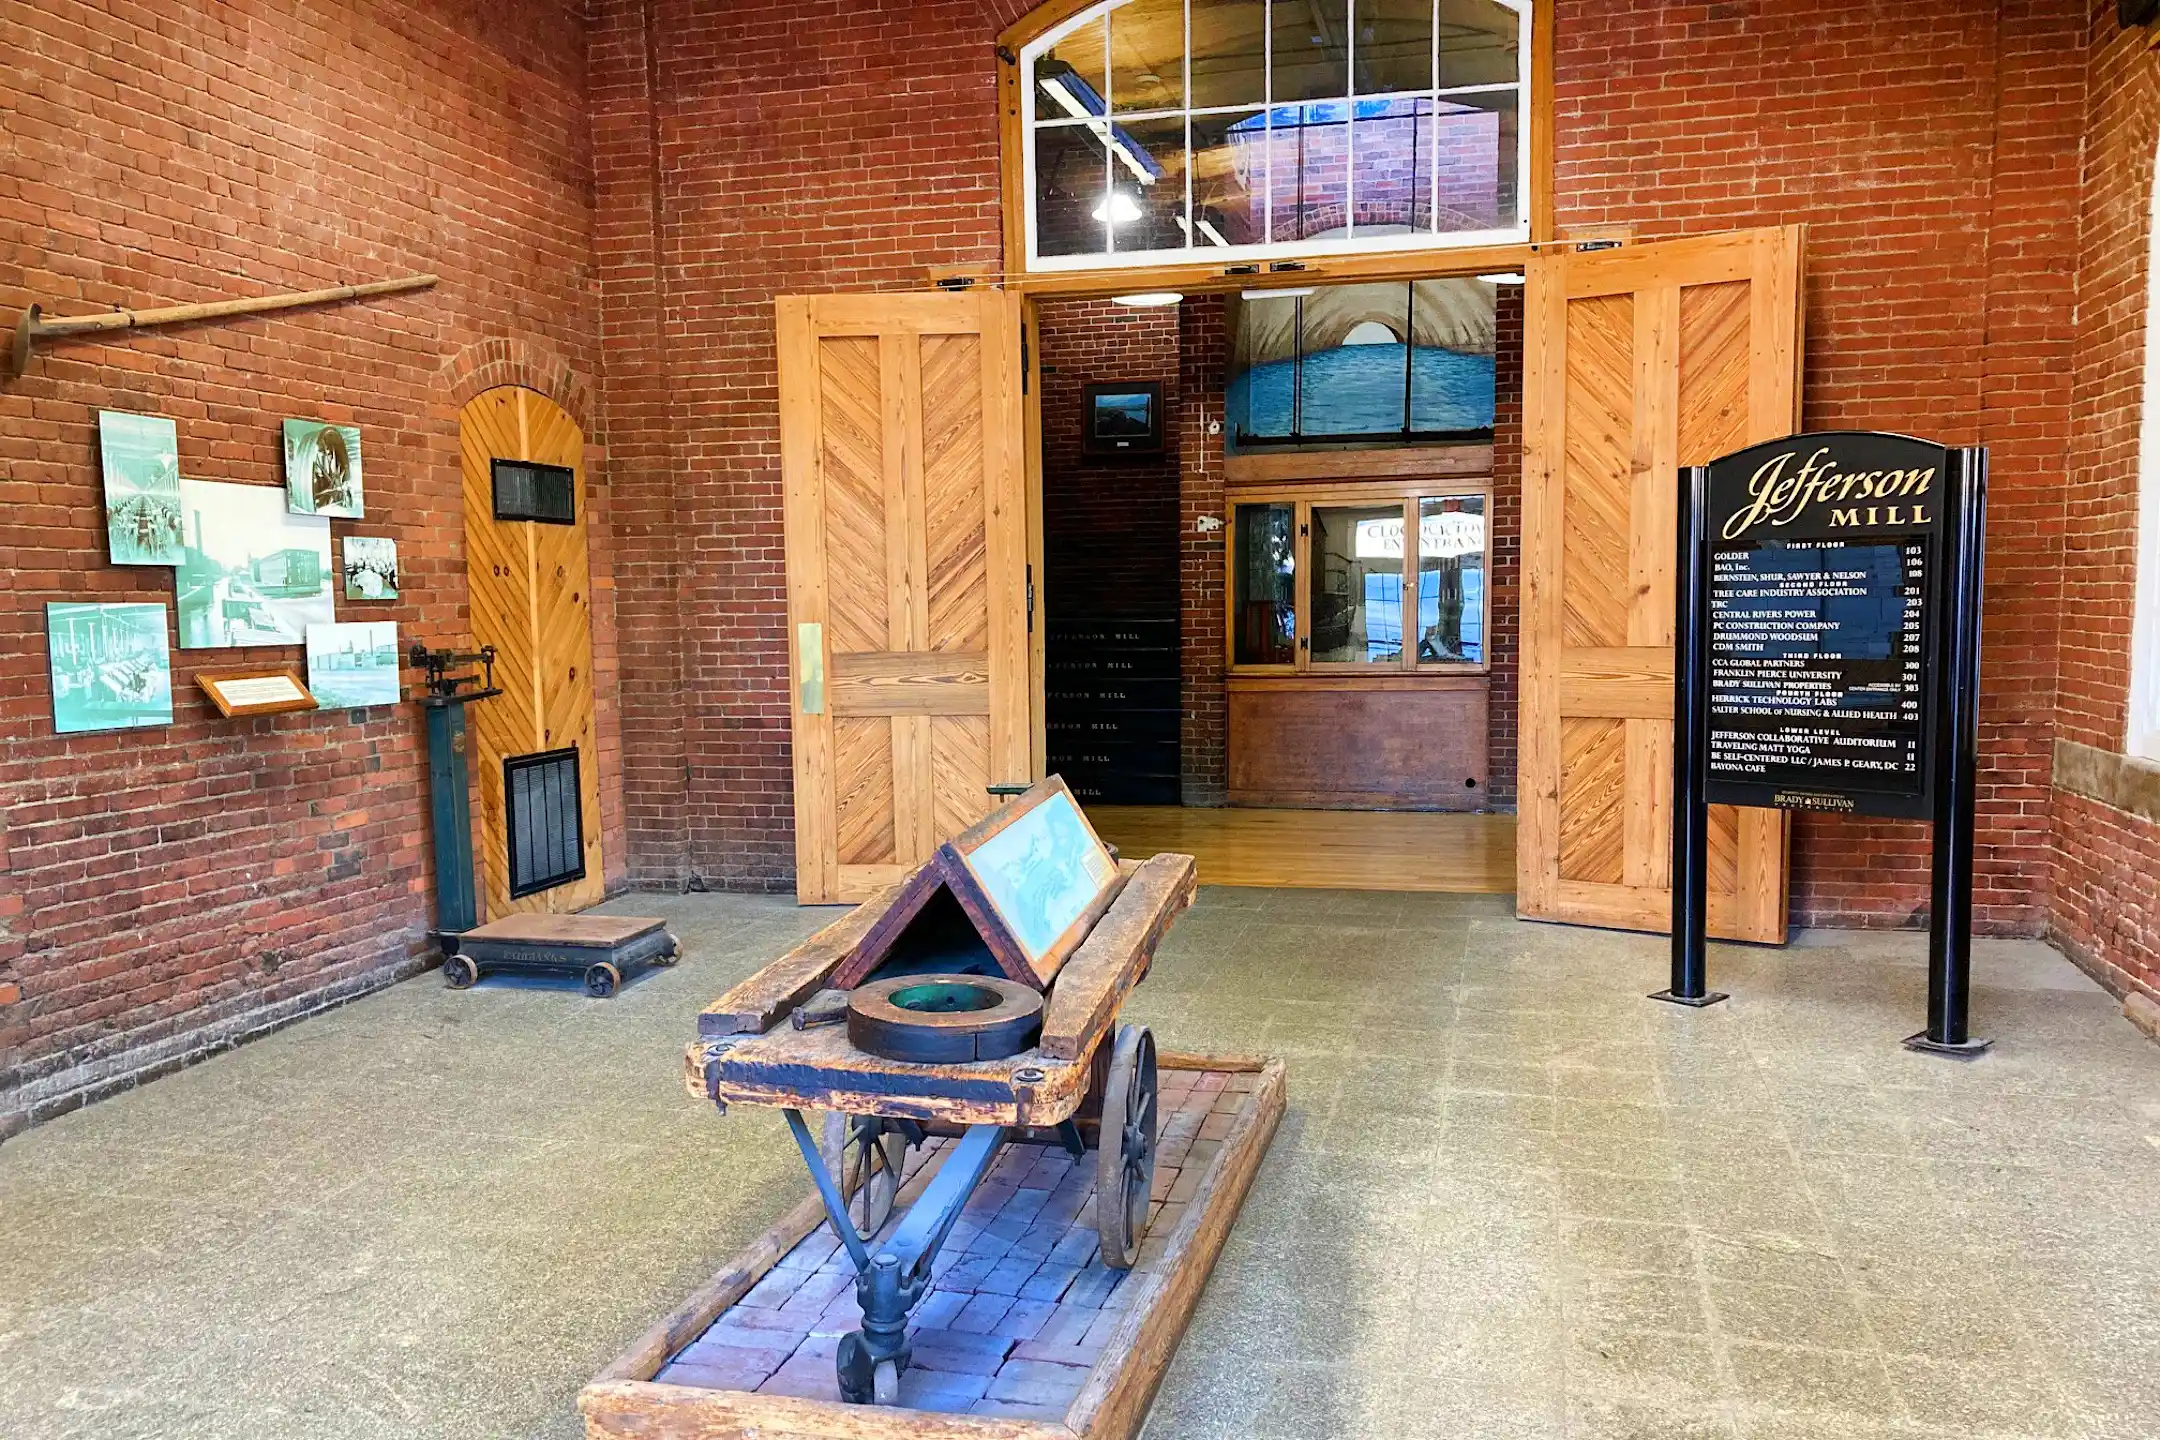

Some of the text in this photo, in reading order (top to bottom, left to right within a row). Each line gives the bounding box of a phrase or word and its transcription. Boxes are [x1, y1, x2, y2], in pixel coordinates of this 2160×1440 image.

[1721, 447, 1936, 540] Jefferson
[1829, 504, 1932, 528] MILL
[1714, 546, 1921, 560] GOLDER 103
[1907, 558, 1922, 566] 106
[1714, 574, 1758, 582] BERNSTEIN,
[1760, 573, 1785, 581] SHUR,
[1909, 570, 1922, 578] 108
[1760, 589, 1805, 597] INDUSTRY
[1806, 588, 1867, 596] ASSOCIATION
[1904, 587, 1920, 595] 201
[1713, 611, 1750, 619] CENTRAL
[1904, 610, 1920, 618] 204
[1903, 622, 1919, 630] 205
[1713, 633, 1920, 642] DRUMMOND WOODSUM 207
[1713, 643, 1733, 651] CDM
[1902, 645, 1919, 653] 208
[1713, 669, 1754, 677] FRANKLIN
[1757, 670, 1787, 678] PIERCE
[1789, 671, 1842, 679] UNIVERSITY
[1904, 684, 1919, 692] 303
[1712, 695, 1917, 709] HERRICK TECHNOLOGY LABS 400
[1712, 706, 1738, 714] SALTER
[1741, 707, 1772, 715] SCHOOL
[1784, 708, 1821, 717] NURSING
[1863, 712, 1897, 720] HEALTH
[1712, 730, 1755, 740] JEFFERSON
[1757, 733, 1829, 744] COLLABORATIVE
[1833, 738, 1896, 748] AUDITORIUM
[1711, 742, 1757, 751] TRAVELING
[1759, 744, 1784, 752] MATT
[1787, 745, 1811, 754] YOGA
[1711, 752, 1721, 760] BE
[1724, 753, 1788, 763] SELF-CENTERED
[1813, 758, 1841, 767] JAMES
[1885, 762, 1899, 770] DC
[1905, 763, 1916, 771] 22
[1711, 762, 1766, 773] BAYONA CAFE
[1774, 794, 1803, 804] BRADY
[1812, 797, 1855, 807] SULLIVAN
